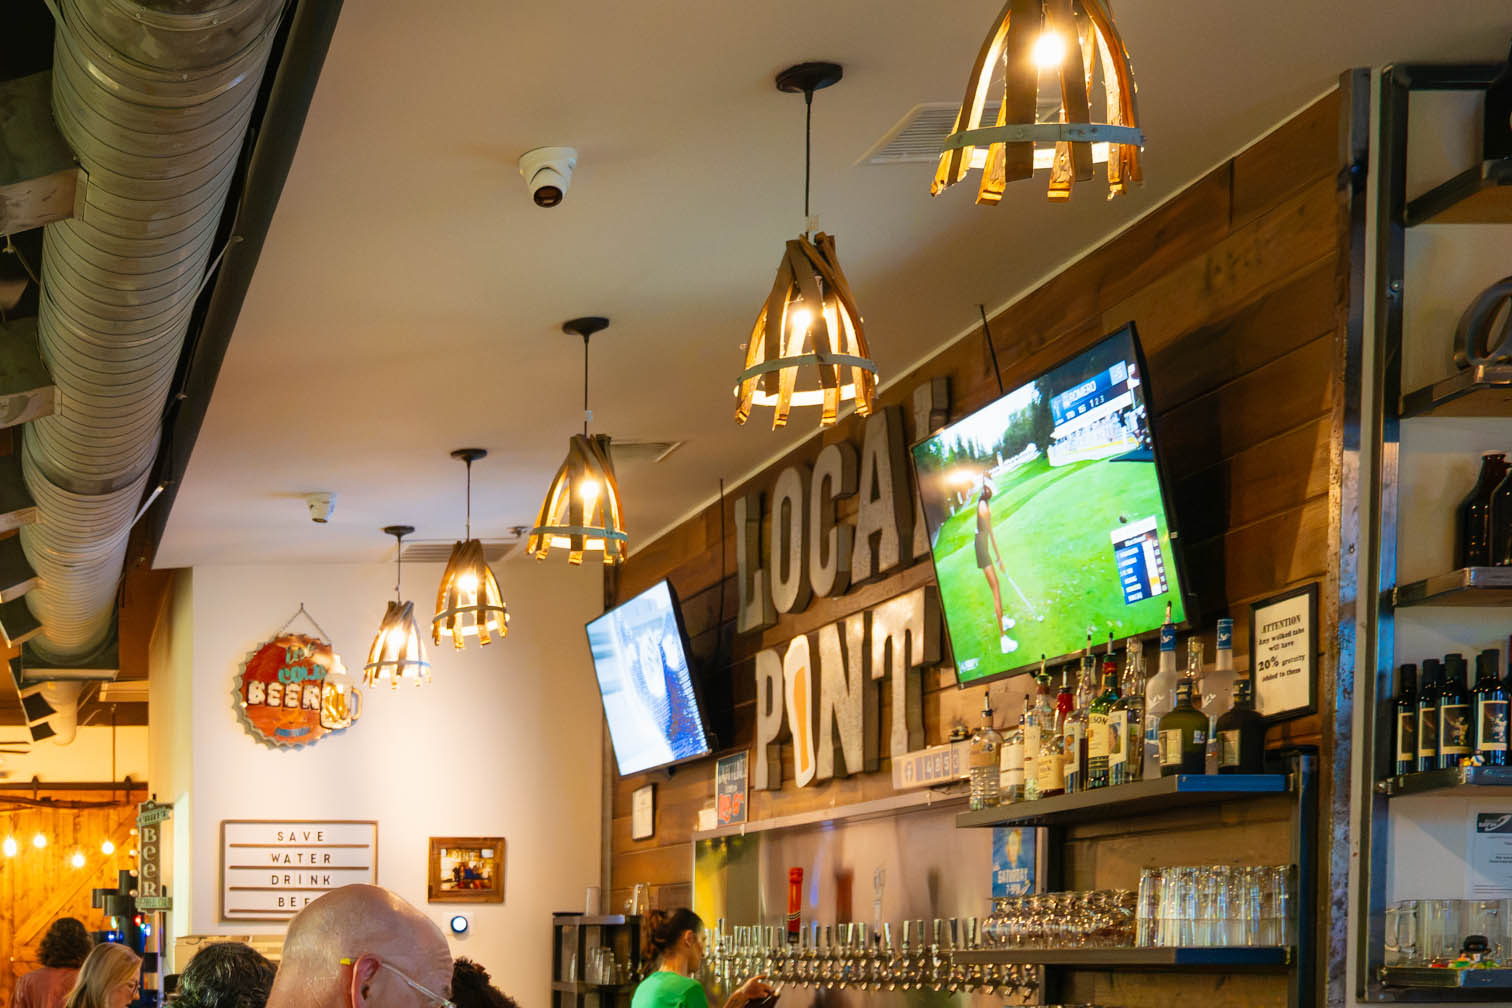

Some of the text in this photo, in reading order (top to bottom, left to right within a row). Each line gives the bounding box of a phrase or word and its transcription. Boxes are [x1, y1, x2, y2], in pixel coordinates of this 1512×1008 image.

[1262, 615, 1301, 633] ATTENTION
[1258, 655, 1279, 672] 20%
[278, 664, 326, 684] COLD
[248, 681, 320, 710] BEER
[277, 831, 324, 841] SAVE
[272, 853, 332, 864] WATER
[271, 874, 330, 885] DRINK
[278, 897, 313, 908] BEE
